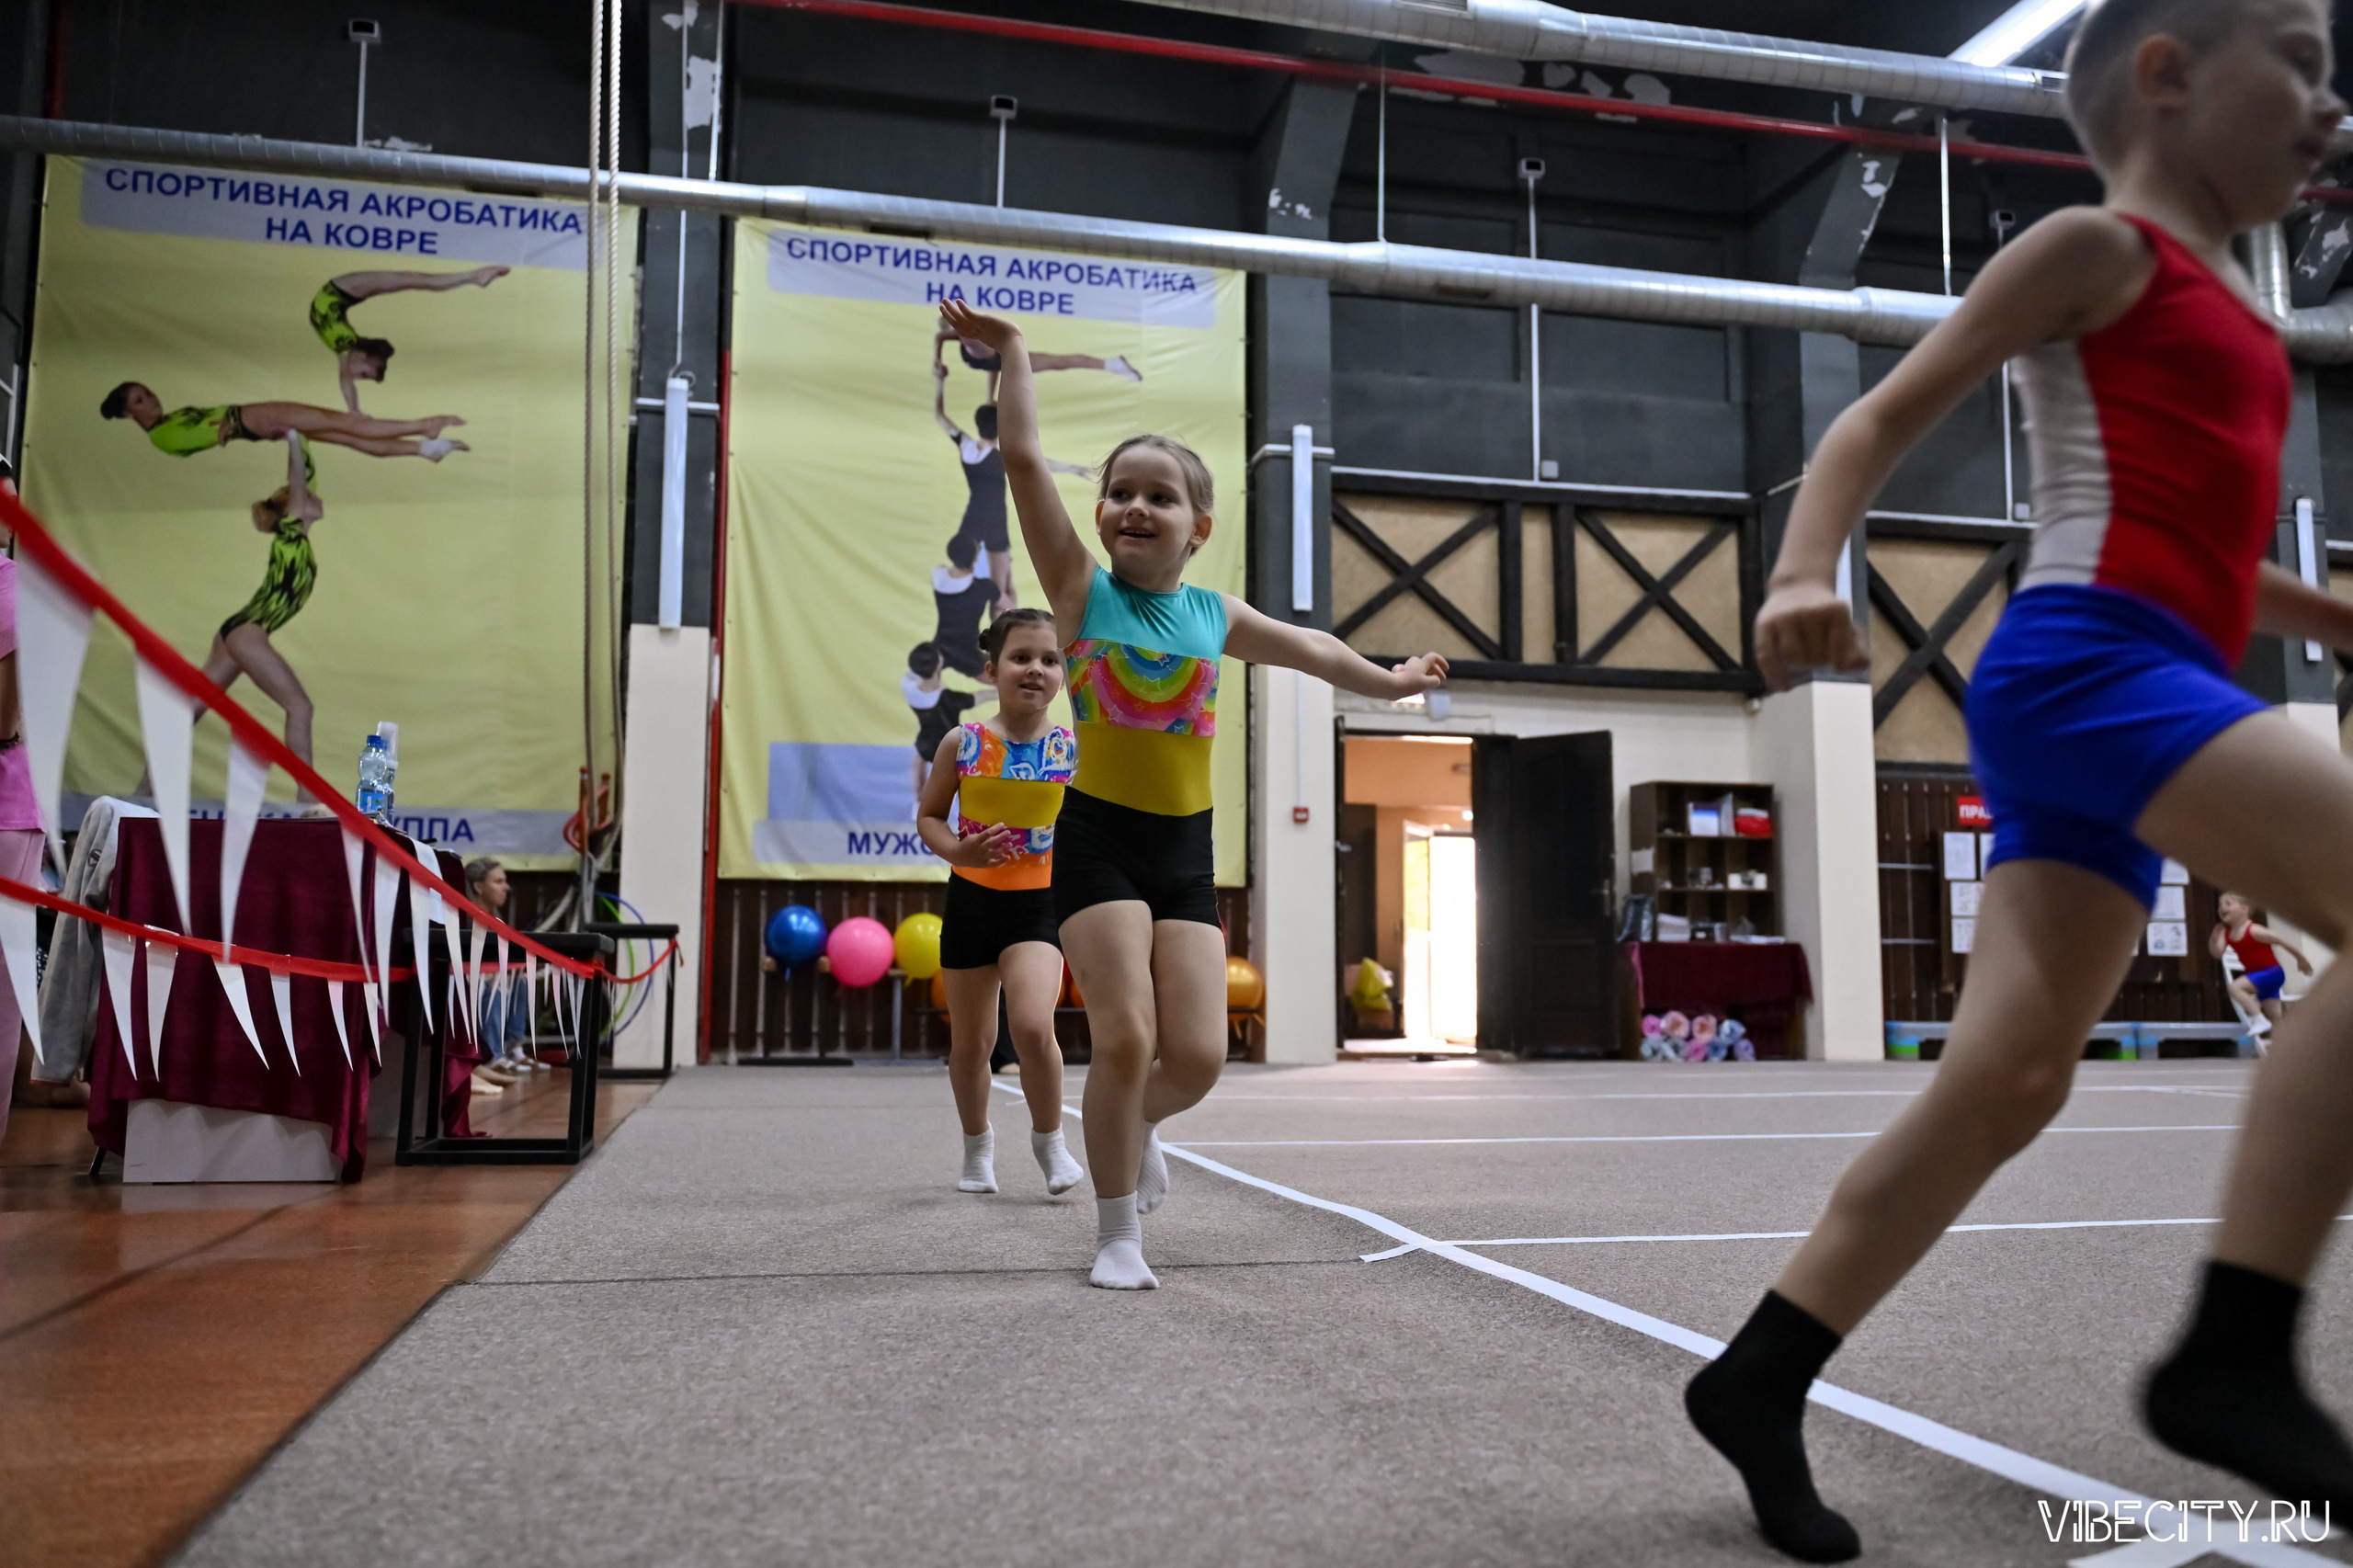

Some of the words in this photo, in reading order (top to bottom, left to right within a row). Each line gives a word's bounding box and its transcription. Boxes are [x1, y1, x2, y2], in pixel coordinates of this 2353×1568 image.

[106, 168, 350, 213] СПОРТИВНАЯ
[359, 193, 583, 234] АКРОБАТИКА
[266, 217, 313, 244] НА
[324, 222, 438, 255] КОВРЕ
[788, 237, 996, 277] СПОРТИВНАЯ
[1006, 256, 1198, 294] АКРОБАТИКА
[926, 282, 967, 304] НА
[977, 286, 1074, 315] КОВРЕ
[1959, 804, 1994, 819] ПРА
